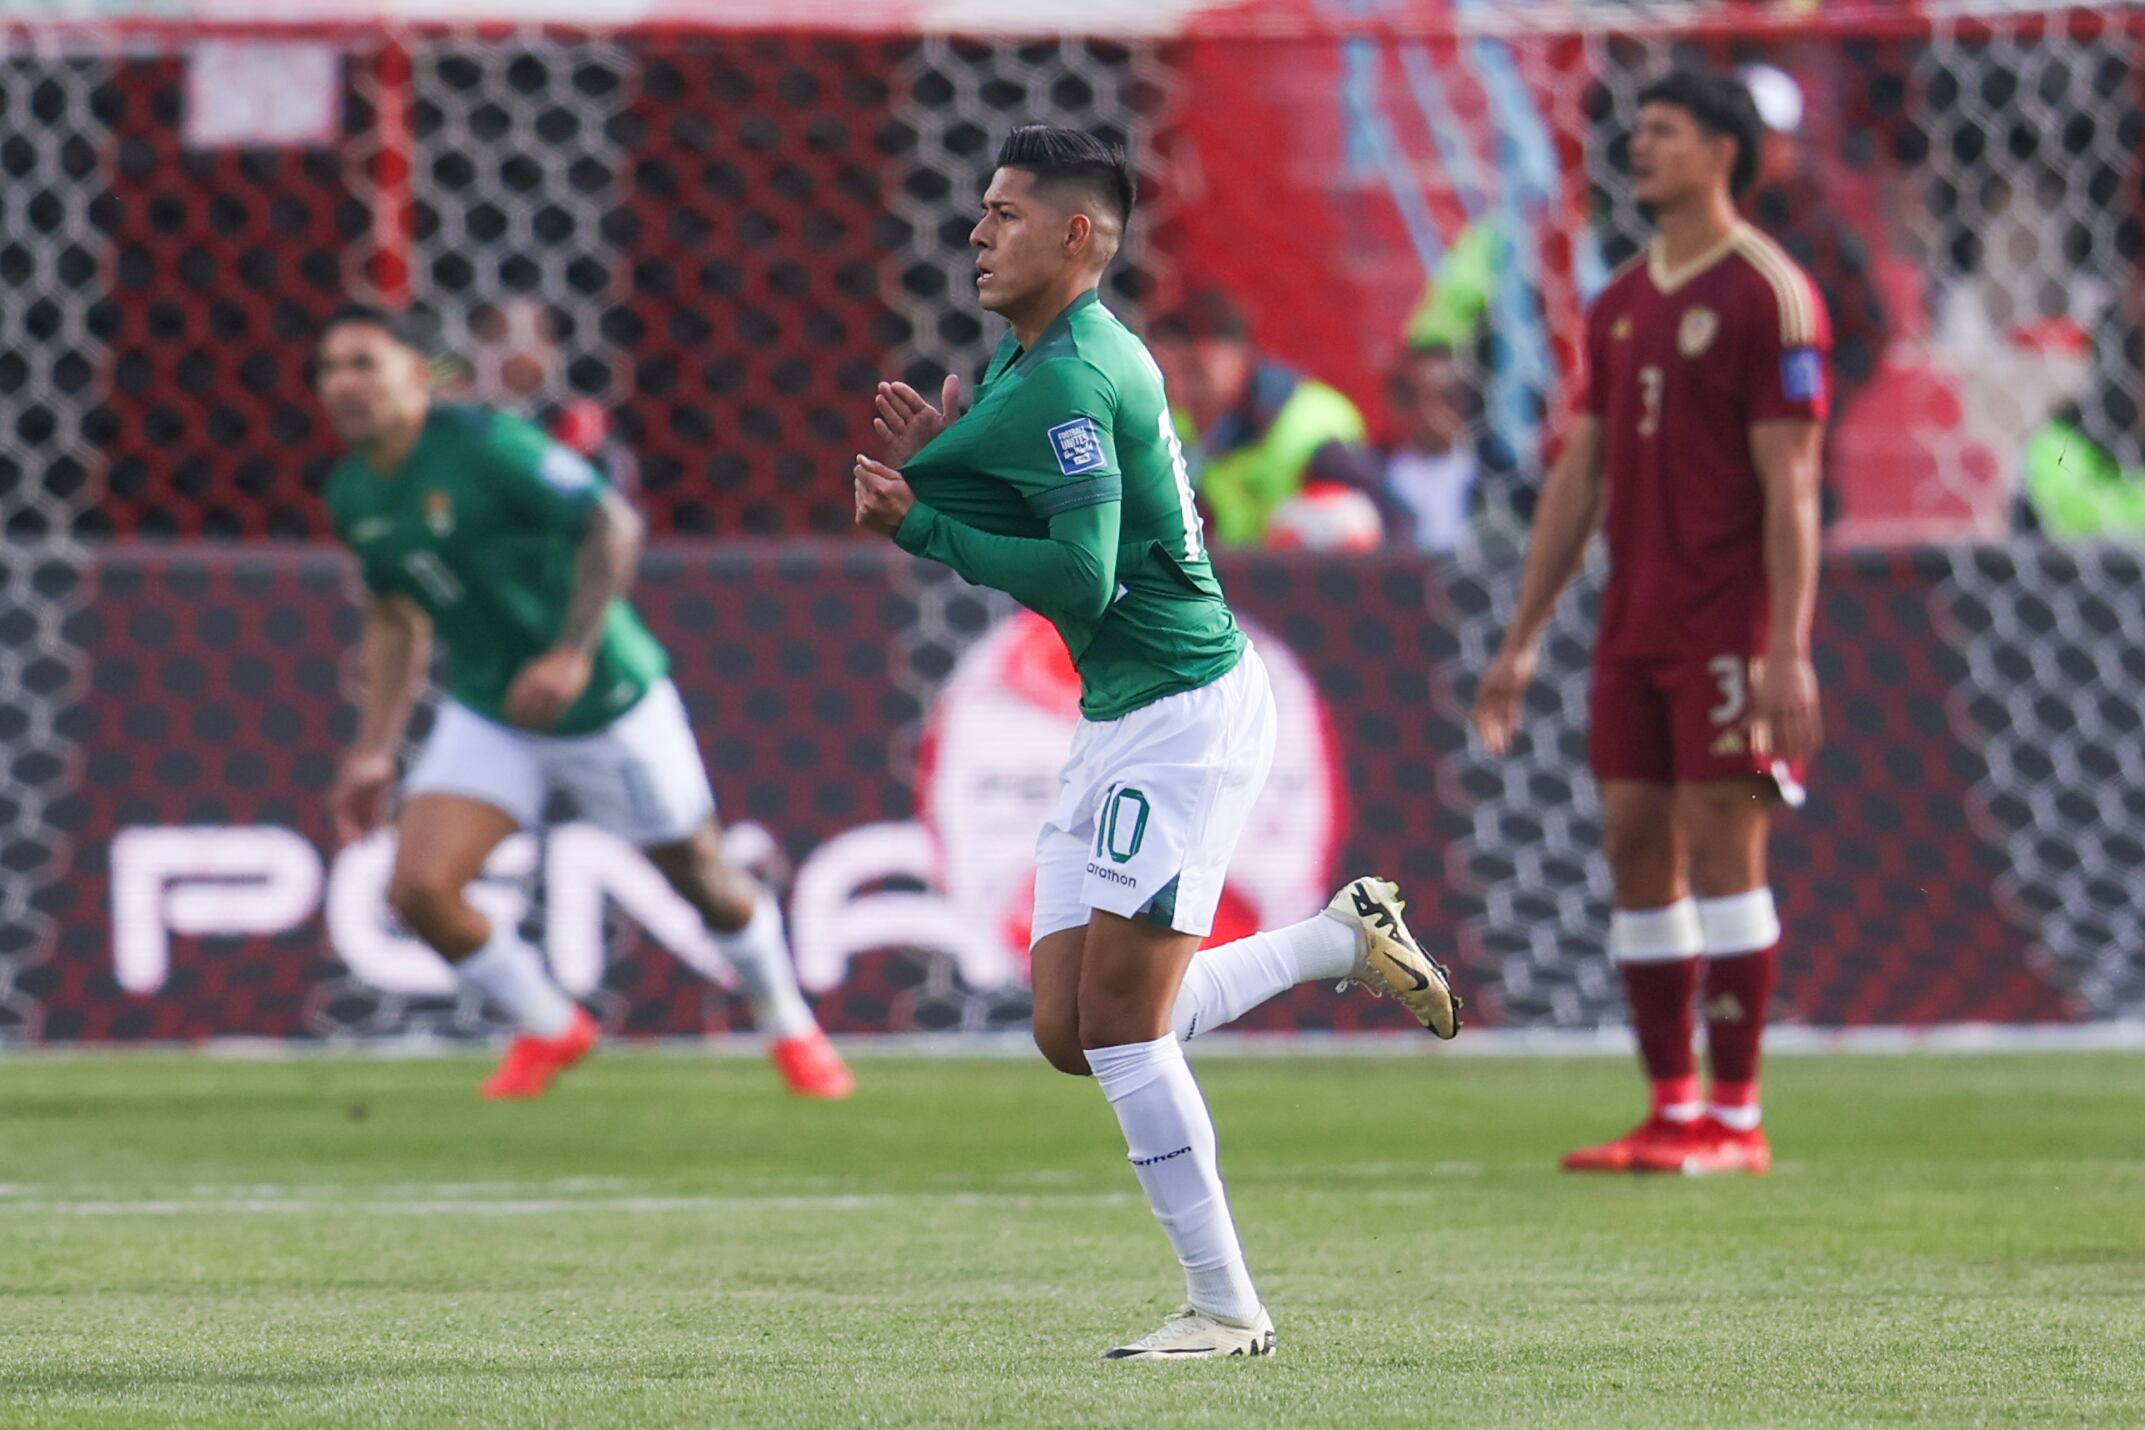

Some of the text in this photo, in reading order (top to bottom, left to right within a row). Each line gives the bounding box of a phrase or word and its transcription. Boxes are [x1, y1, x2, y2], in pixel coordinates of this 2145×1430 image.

[1706, 653, 1745, 726] 3
[1096, 780, 1150, 864] 10
[1127, 1146, 1192, 1166] athon
